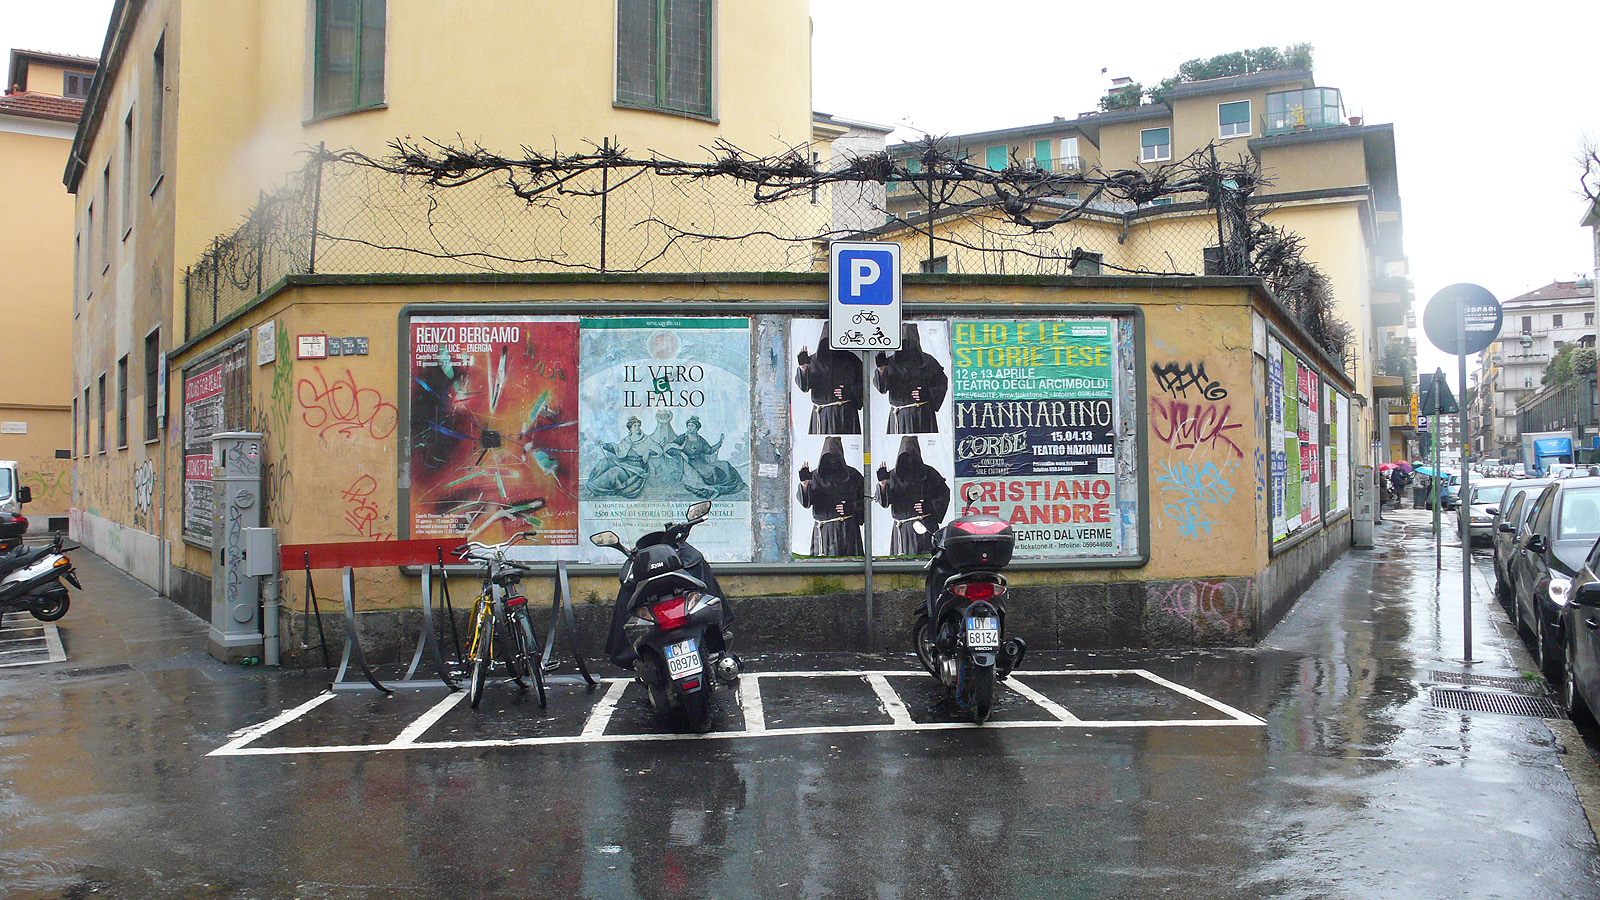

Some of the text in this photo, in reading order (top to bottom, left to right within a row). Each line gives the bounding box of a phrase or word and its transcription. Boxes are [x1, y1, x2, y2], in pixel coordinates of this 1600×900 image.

[850, 258, 881, 297] P
[416, 326, 520, 343] RENZO BERGAMO
[955, 322, 1067, 345] ELIO E LE
[416, 344, 438, 353] ATOMO
[445, 344, 460, 353] LUCE
[466, 343, 493, 352] ENERGIA
[956, 345, 1109, 368] STORIE TESE
[624, 365, 705, 383] IL VERO
[956, 368, 1036, 380] 12 e 13 APRILE
[956, 378, 1109, 391] TEATRO DEGLI ARCIMBOLDI
[624, 390, 706, 408] IL FALSO
[955, 400, 1112, 429] MANNARINO
[957, 430, 1028, 460] CORDE
[1050, 431, 1094, 443] 15.04.13
[1031, 444, 1113, 456] TEATRO NAZIONALE
[960, 479, 1111, 503] CRISTIANO
[961, 501, 1111, 525] DE ANDRÉ
[1013, 528, 1112, 541] TEATRO DAL VERME
[974, 618, 985, 629] DY
[969, 632, 998, 644] 68134
[671, 642, 684, 656] CY
[669, 654, 699, 672] 08978
